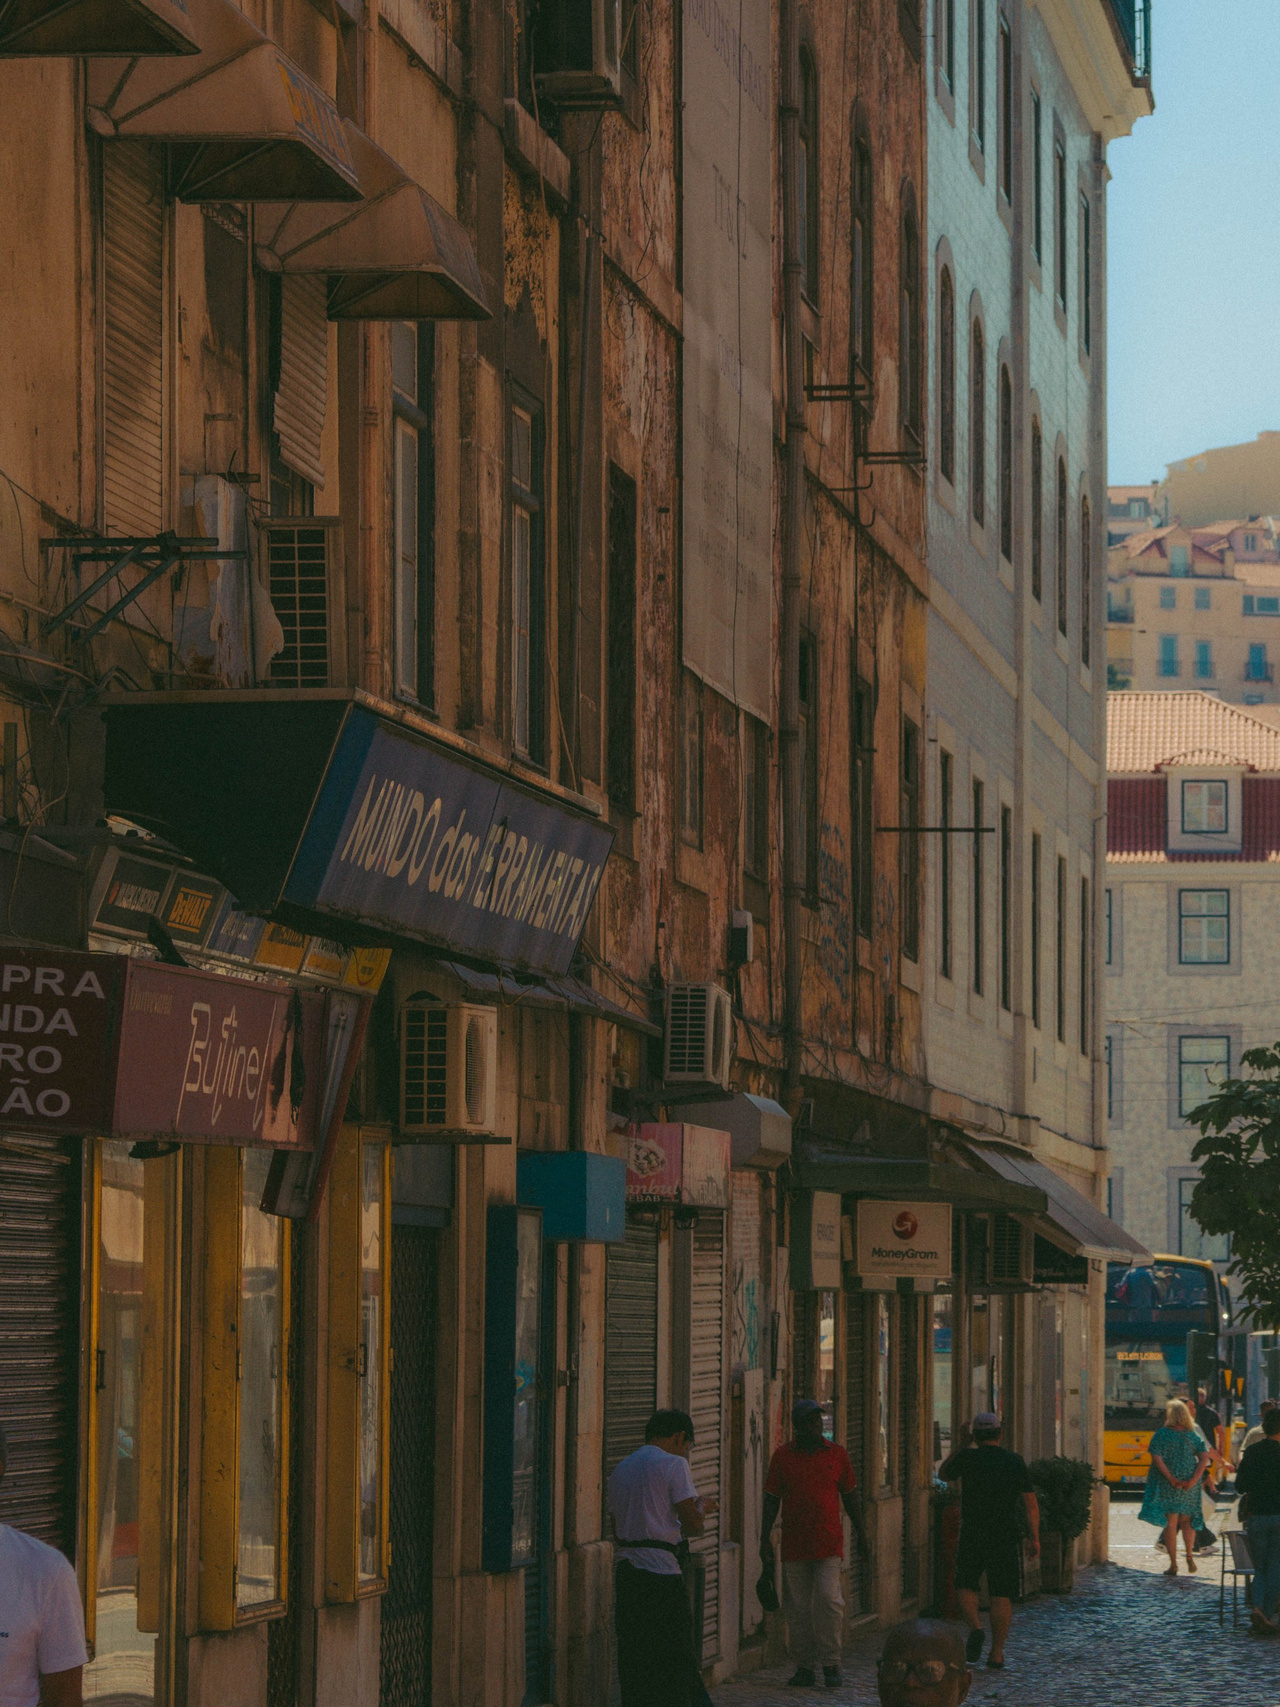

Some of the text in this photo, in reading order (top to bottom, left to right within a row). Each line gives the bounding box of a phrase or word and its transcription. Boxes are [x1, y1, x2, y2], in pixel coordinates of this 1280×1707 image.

[340, 774, 600, 940] MUNDO das FERRAMENTAS
[2, 964, 106, 999] PRA
[0, 1042, 63, 1074] RO
[0, 1077, 71, 1118] ÃO
[627, 1194, 660, 1202] EBAB
[871, 1246, 938, 1260] MoneyGram
